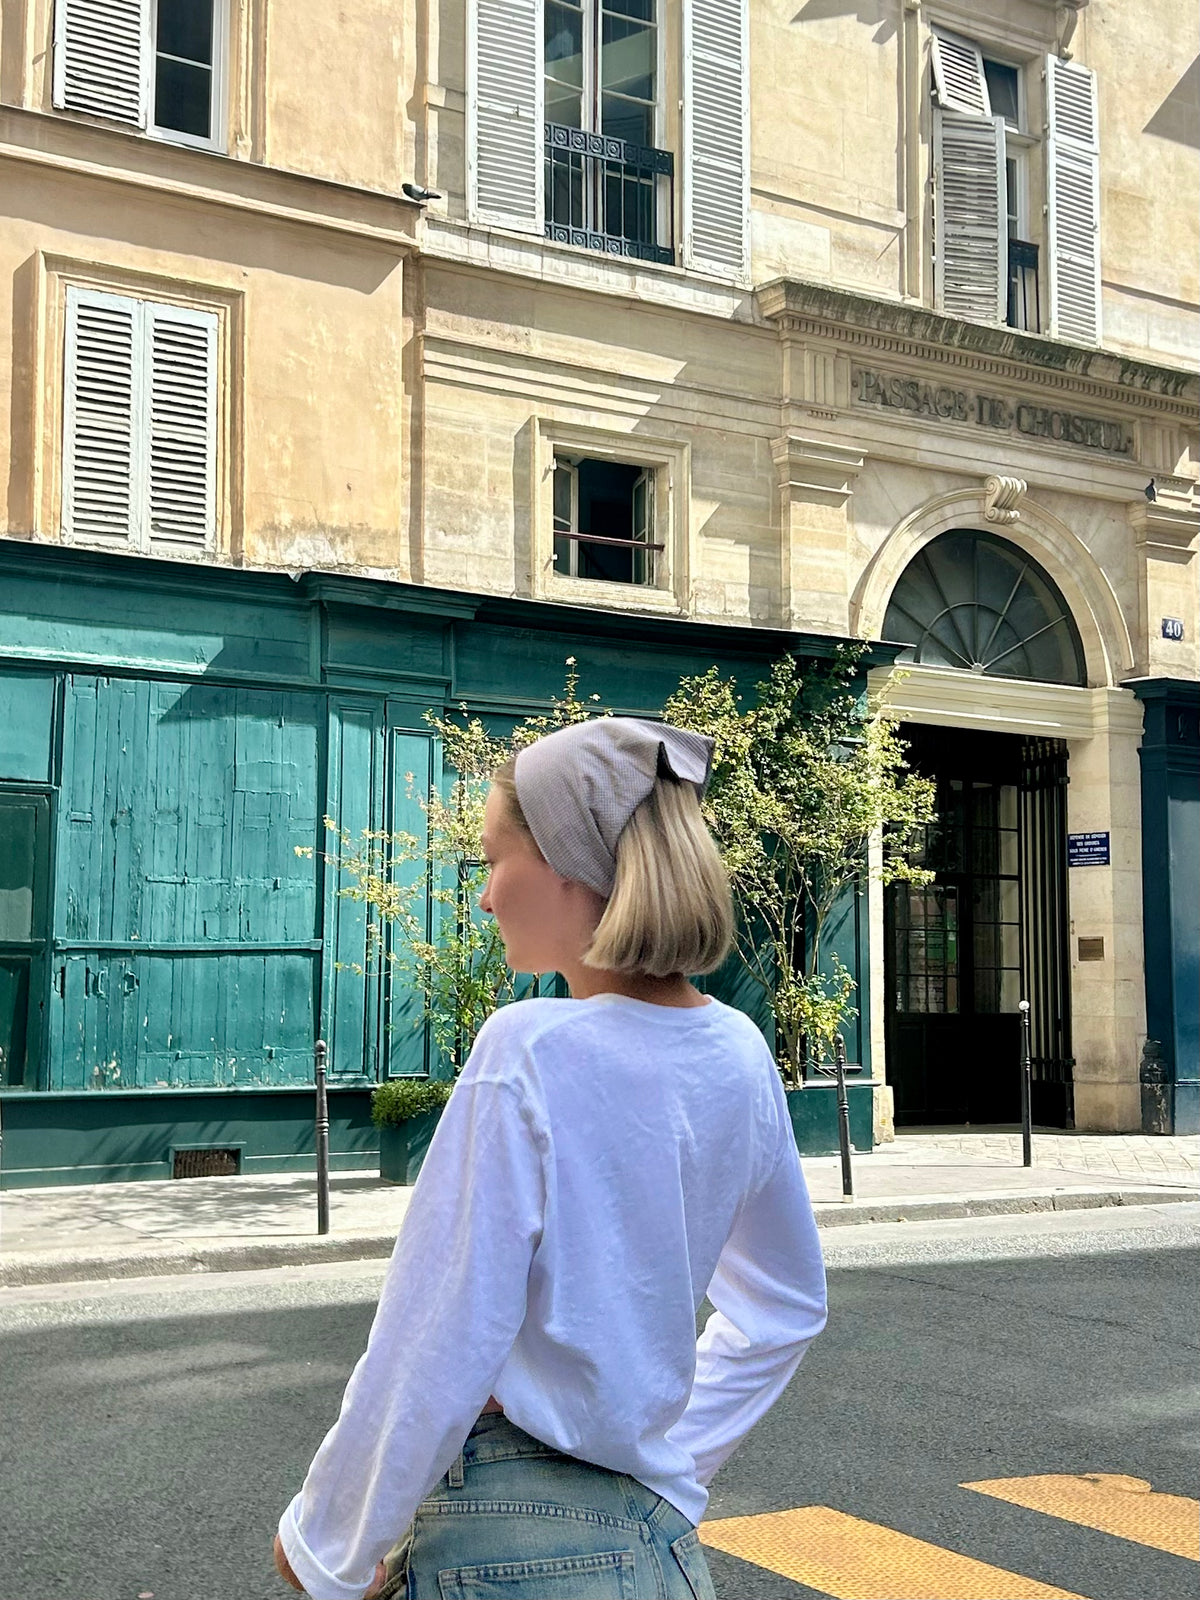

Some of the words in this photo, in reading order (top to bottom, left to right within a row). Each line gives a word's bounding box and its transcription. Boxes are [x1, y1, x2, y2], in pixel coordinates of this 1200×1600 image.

[858, 370, 968, 422] PASSAGE
[975, 394, 1008, 429] DE
[1016, 404, 1129, 453] CHOISEUL
[1165, 620, 1181, 637] 40
